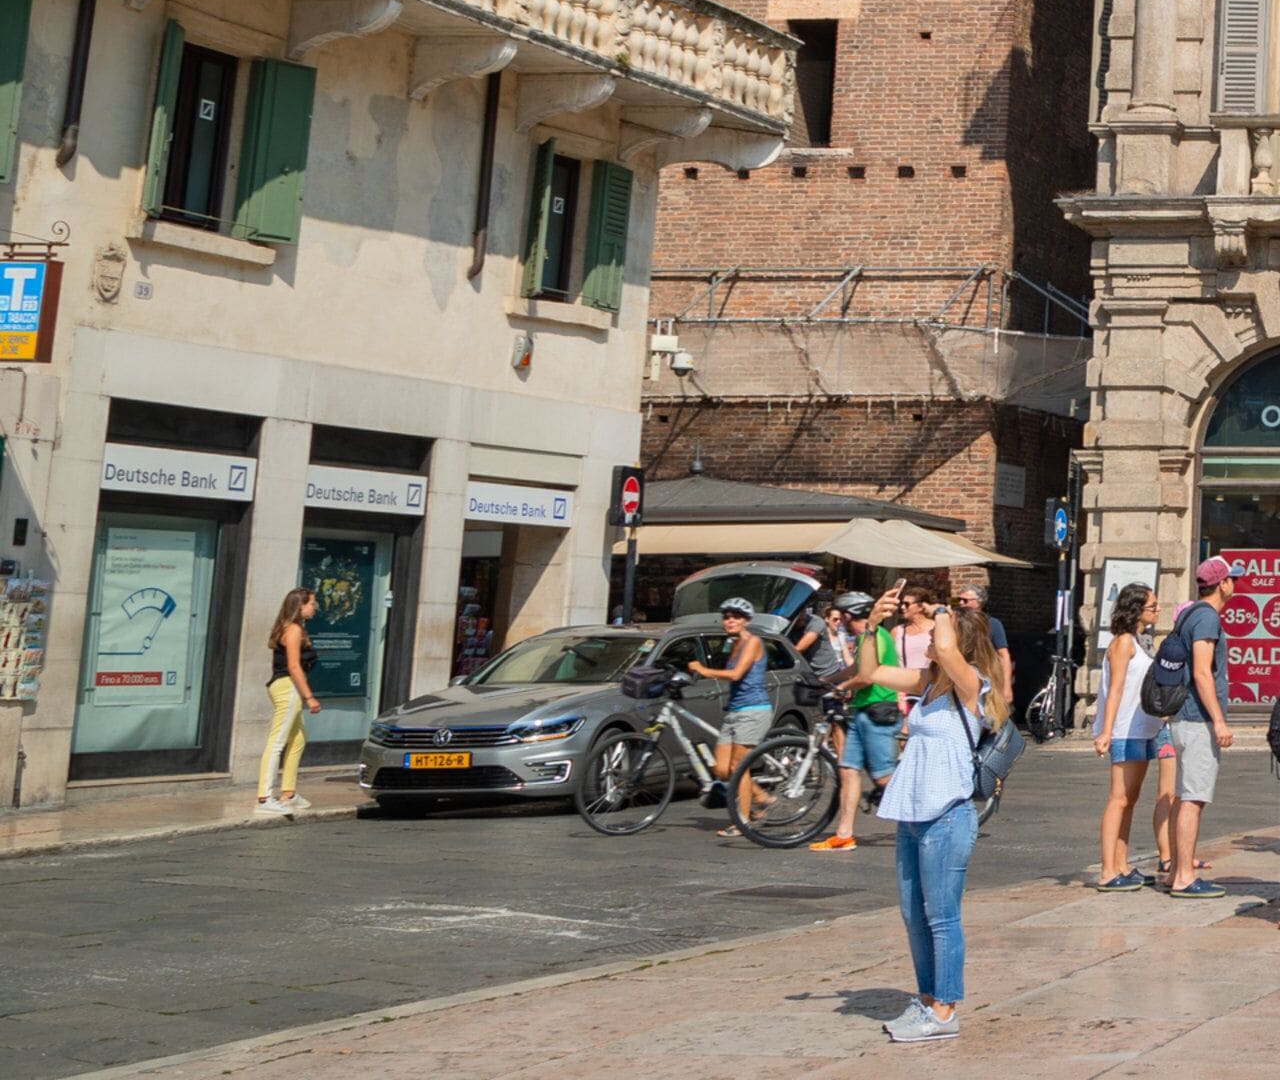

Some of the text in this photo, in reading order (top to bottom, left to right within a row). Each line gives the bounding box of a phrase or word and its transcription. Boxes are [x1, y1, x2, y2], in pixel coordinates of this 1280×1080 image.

[4, 267, 37, 311] T
[105, 463, 217, 490] Deutsche Bank
[306, 483, 398, 506] Deutsche Bank
[469, 497, 547, 518] Deutsche Bank
[1251, 578, 1276, 587] SALE
[1220, 609, 1258, 624] -35%
[1248, 667, 1272, 675] SALE
[415, 755, 465, 767] HT-126-R
